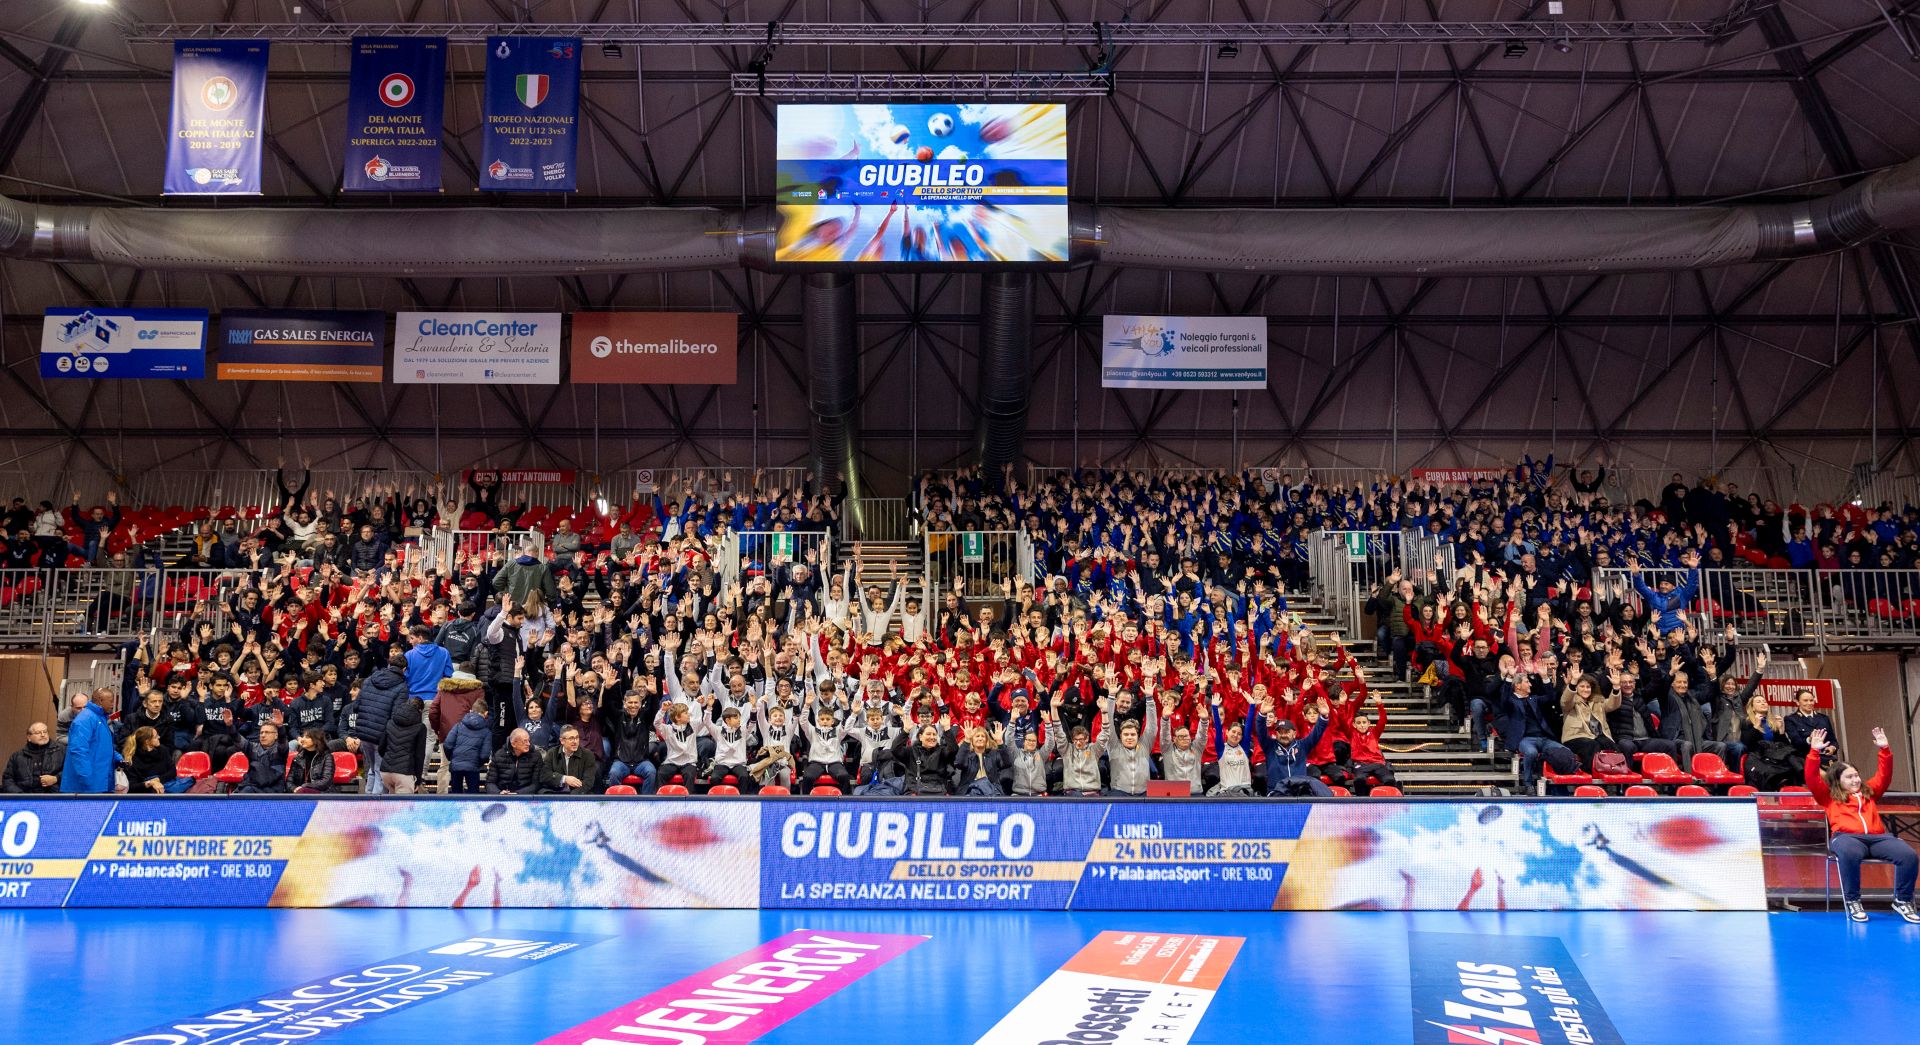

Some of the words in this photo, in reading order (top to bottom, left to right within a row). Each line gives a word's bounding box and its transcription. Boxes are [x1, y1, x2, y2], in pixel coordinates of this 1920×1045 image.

[191, 119, 207, 127] DEL
[211, 119, 244, 127] MONTE
[368, 115, 385, 123] DEL
[387, 115, 422, 124] MONTE
[488, 115, 522, 123] TROFEO
[524, 115, 574, 124] NAZIONALE
[178, 130, 210, 138] COPPA
[212, 130, 242, 138] ITALIA
[243, 130, 255, 138] A2
[363, 126, 395, 134] COPPA
[397, 126, 426, 134] ITALIA
[494, 126, 527, 134] VOLLEY
[529, 126, 546, 134] U12
[547, 127, 566, 135] 3vs3
[190, 141, 212, 149] 2018
[220, 141, 242, 149] 2019
[351, 138, 395, 146] SUPERLEGA
[397, 138, 437, 146] 2022-2023
[509, 137, 553, 145] 2022-2023
[544, 173, 566, 181] VOLLEY
[859, 164, 984, 186] GIUBILEO
[946, 187, 983, 195] SPORTIVO
[418, 318, 538, 337] CleanCenter
[254, 329, 279, 340] GAS
[281, 329, 317, 341] SALES
[320, 330, 374, 342] ENERGIA
[1180, 332, 1218, 343] Noleggio
[1219, 332, 1250, 343] furgoni
[1251, 333, 1256, 341] &
[404, 336, 474, 353] Lavanderia
[478, 336, 497, 353] &
[497, 335, 549, 353] Sartoria
[615, 338, 718, 354] themalibero
[1181, 344, 1209, 353] veicoli
[1210, 344, 1262, 354] professionali
[502, 472, 561, 482] SANT'ANTONINO
[1425, 471, 1451, 481] CURVA
[117, 818, 167, 836] LUNEDÌ
[1113, 821, 1163, 839] LUNEDÌ
[781, 811, 1036, 859] GIUBILEO
[116, 839, 137, 857] 24
[142, 839, 228, 857] NOVEMBRE
[233, 839, 273, 857] 2025
[1115, 842, 1135, 860] 24
[1140, 842, 1226, 860] NOVEMBRE
[1231, 842, 1271, 860] 2025
[109, 862, 210, 880] PalabancaSport
[221, 864, 242, 878] ORE
[245, 864, 272, 878] 18.00
[907, 864, 956, 877] DELLO
[959, 864, 1034, 878] SPORTIVO
[1109, 865, 1211, 884] PalabancaSport
[1222, 867, 1242, 880] ORE
[1245, 867, 1273, 880] 18.00
[781, 883, 806, 899] LA
[808, 883, 906, 899] SPERANZA
[910, 883, 969, 900] NELLO
[972, 883, 1033, 900] SPORT
[1521, 965, 1563, 986] dei
[1443, 960, 1536, 1029] Zeus
[1530, 985, 1579, 1005] gli
